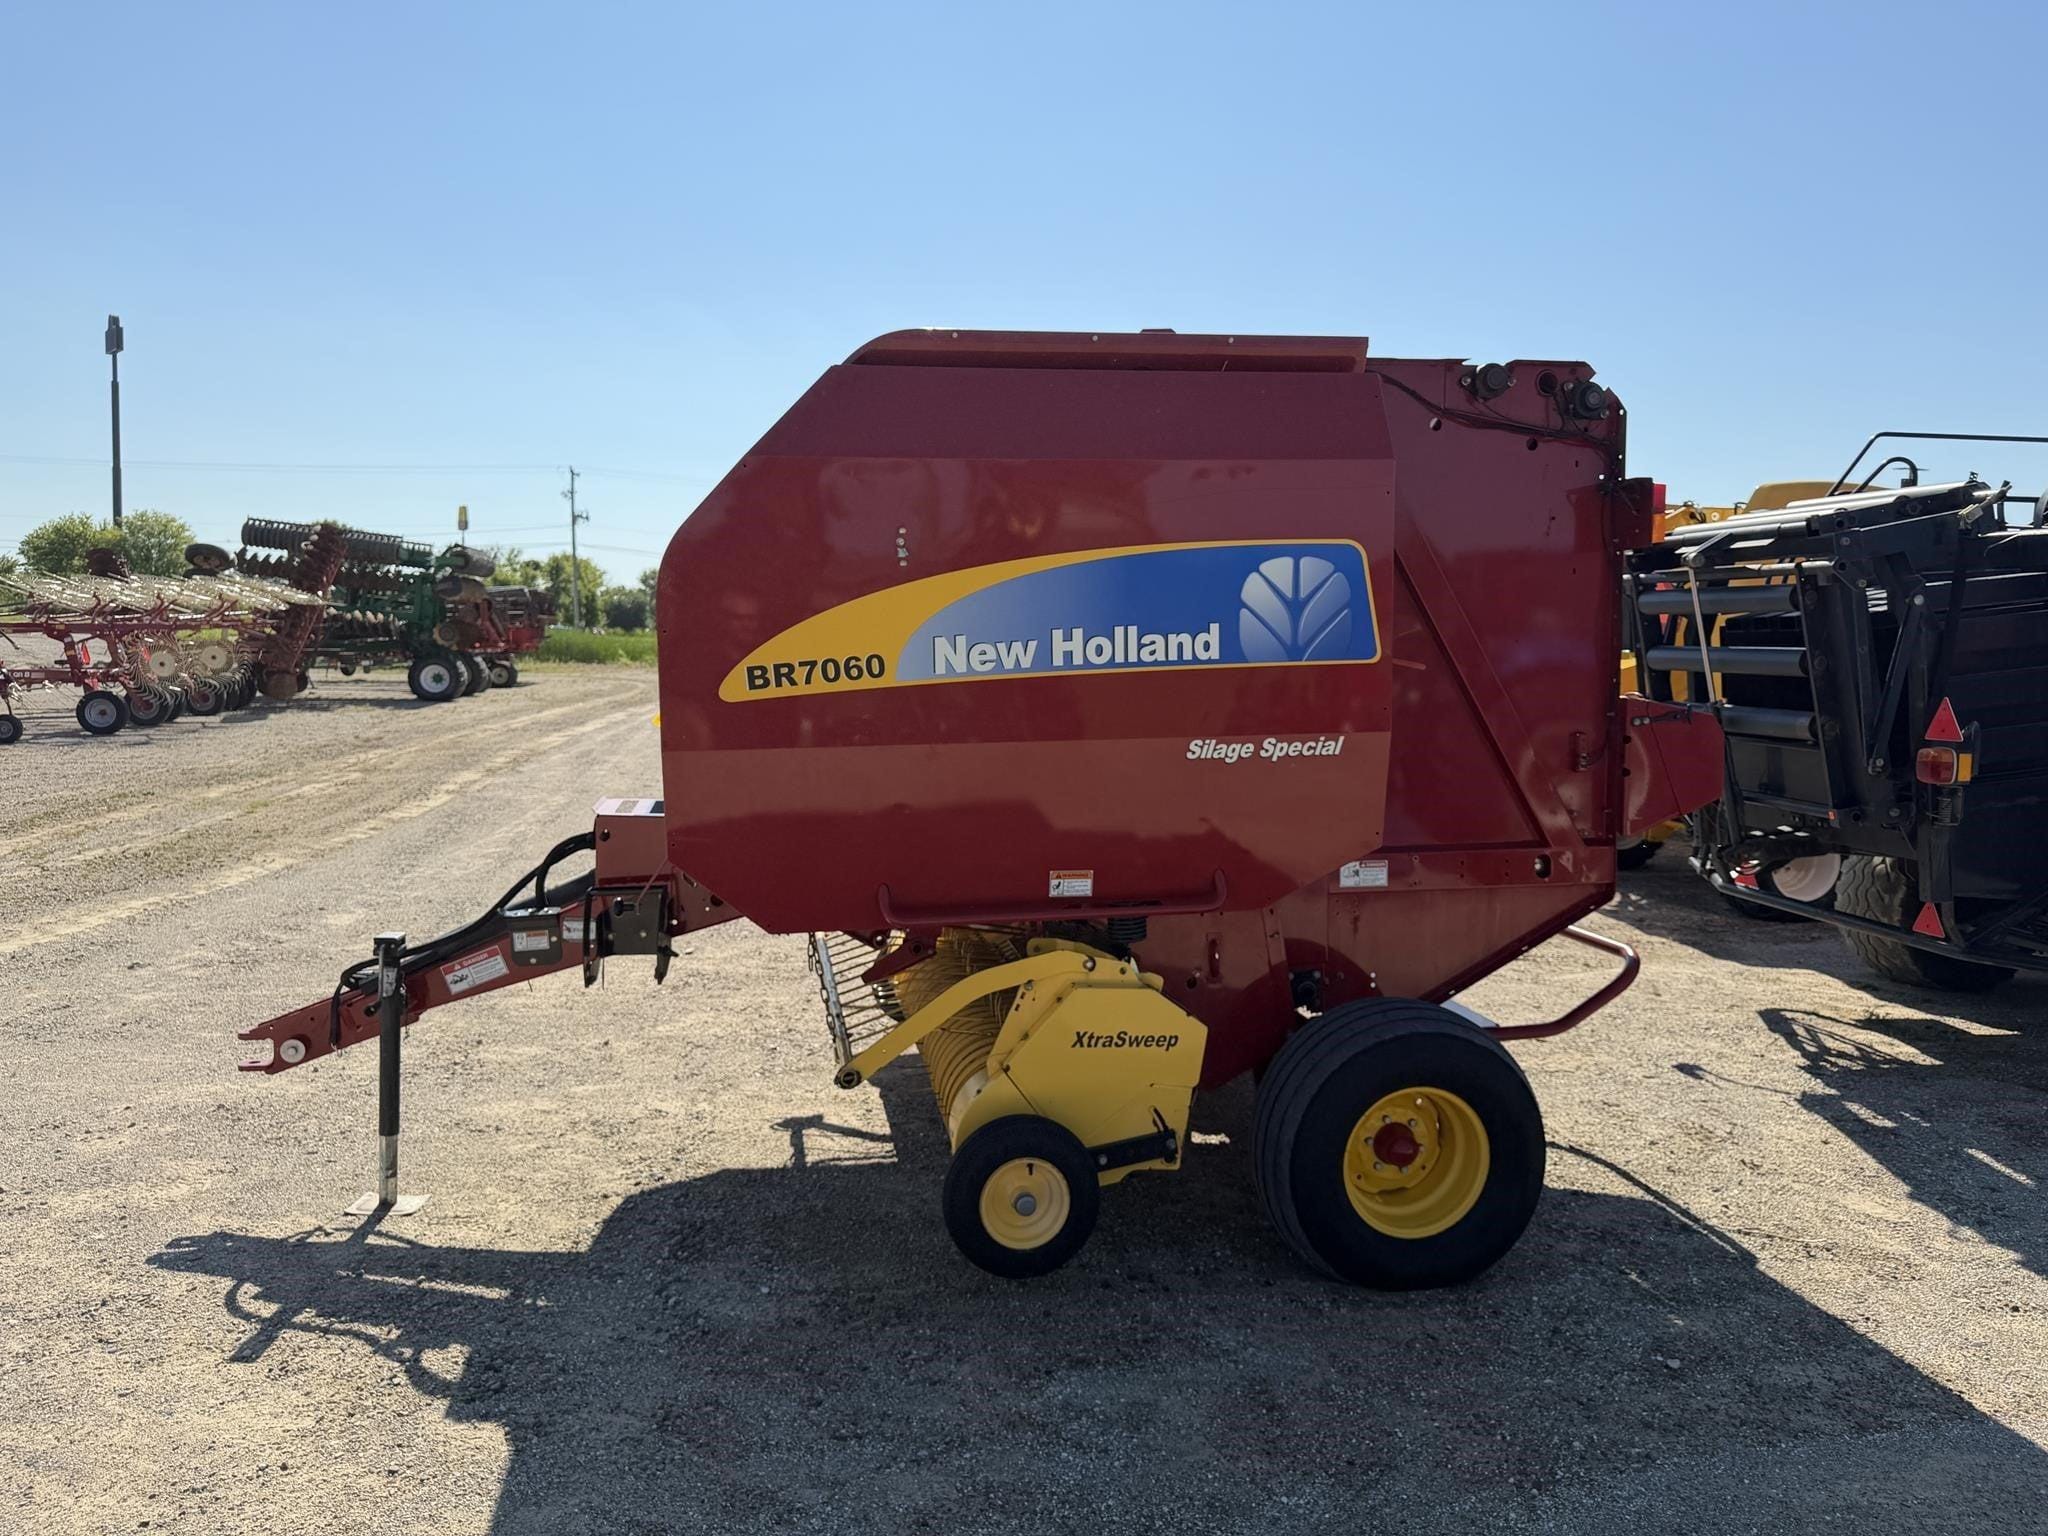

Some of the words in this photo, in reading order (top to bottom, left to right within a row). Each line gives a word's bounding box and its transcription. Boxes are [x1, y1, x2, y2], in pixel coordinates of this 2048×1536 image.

[933, 633, 1038, 674] New
[1051, 622, 1220, 666] Holland
[746, 654, 885, 690] BR7060
[1186, 739, 1254, 764] Silage
[1260, 735, 1344, 761] Special
[1071, 1030, 1179, 1051] XtraSweep
